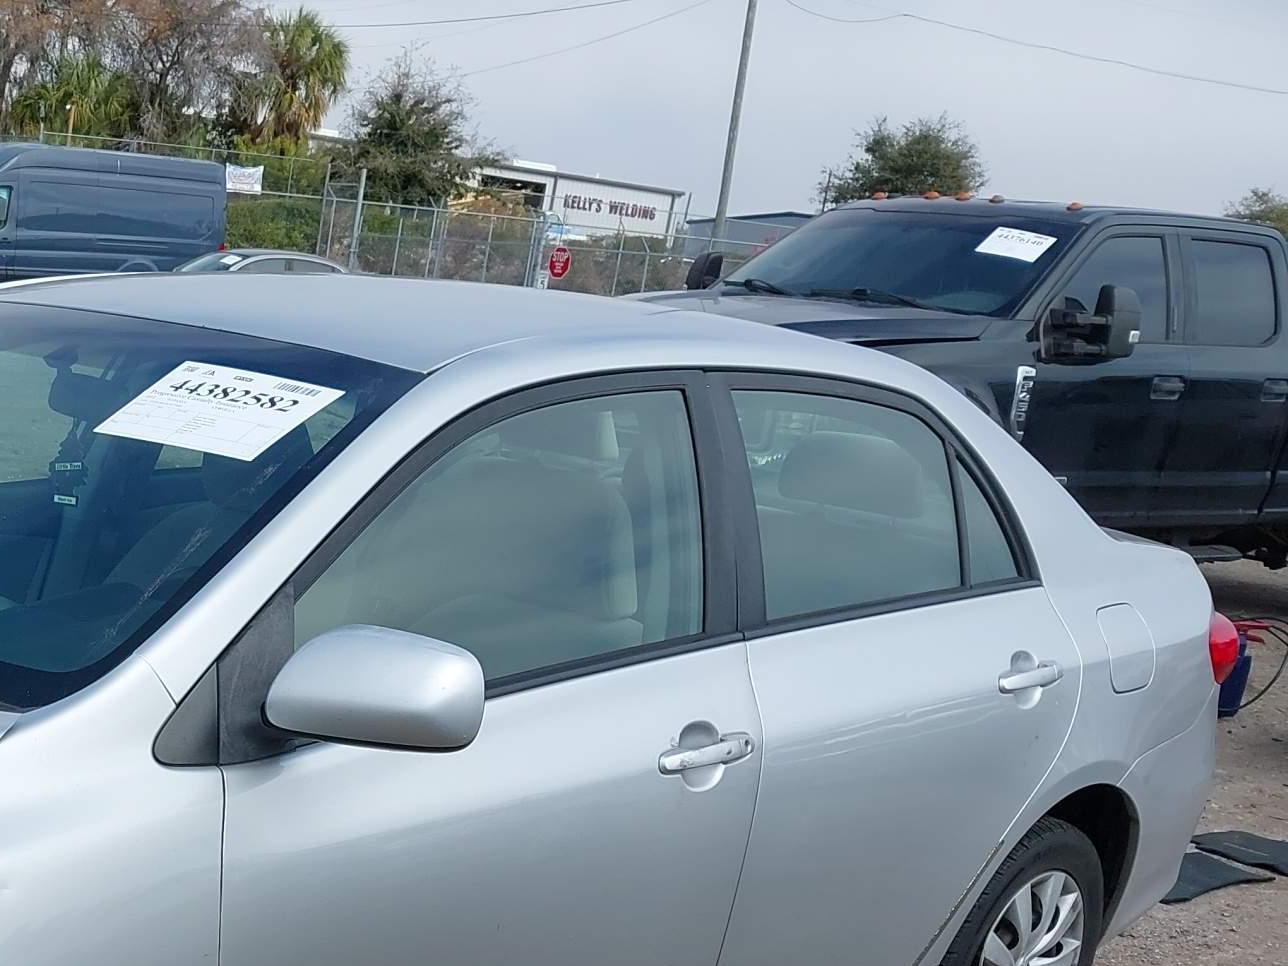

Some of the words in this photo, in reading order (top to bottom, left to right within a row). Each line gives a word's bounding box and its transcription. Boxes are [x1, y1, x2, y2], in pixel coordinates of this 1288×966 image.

[563, 194, 603, 213] KELLY'S
[608, 200, 657, 220] WELDING
[552, 251, 569, 263] STOP
[169, 379, 300, 412] 44382582
